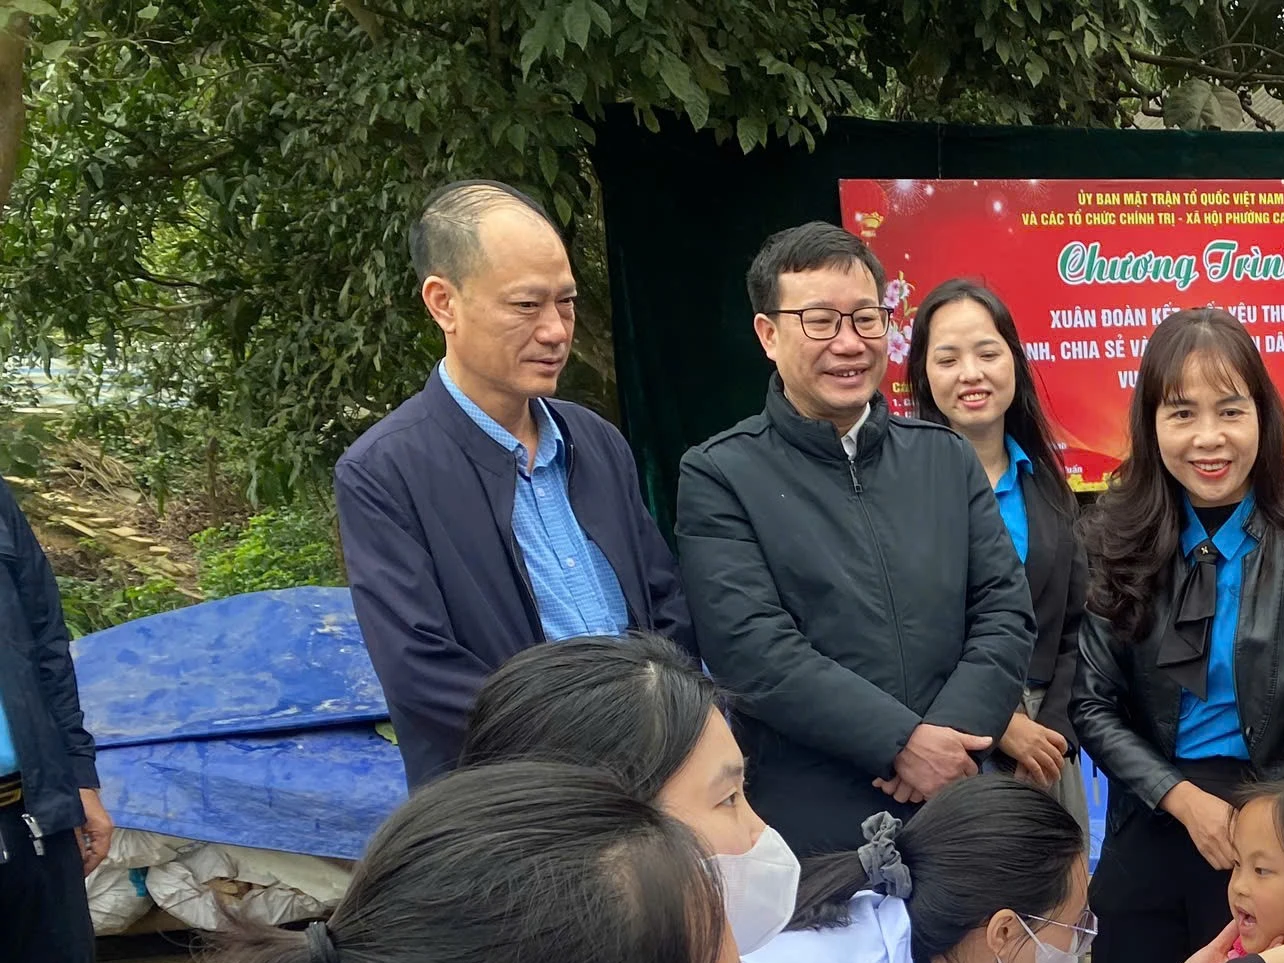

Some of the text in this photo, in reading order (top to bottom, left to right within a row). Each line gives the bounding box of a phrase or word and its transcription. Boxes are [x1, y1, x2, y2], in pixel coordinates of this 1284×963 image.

[1078, 189, 1284, 206] ỦY BAN MẶT TRẬN TỔ QUỐC VIỆT NAM
[1022, 210, 1038, 225] VÀ
[1041, 210, 1065, 225] CÁC
[1068, 209, 1083, 225] TỔ
[1085, 210, 1116, 224] CHỨC
[1120, 210, 1154, 224] CHÍNH
[1158, 212, 1175, 226] TRỊ
[1186, 210, 1201, 224] XÃ
[1204, 210, 1223, 226] HỘI
[1226, 209, 1269, 224] PHƯỜNG
[1058, 240, 1197, 291] Chương
[1050, 308, 1096, 329] XUÂN
[1101, 304, 1147, 327] ĐOÀN
[1060, 339, 1100, 360] CHIA
[1104, 333, 1125, 358] SẺ
